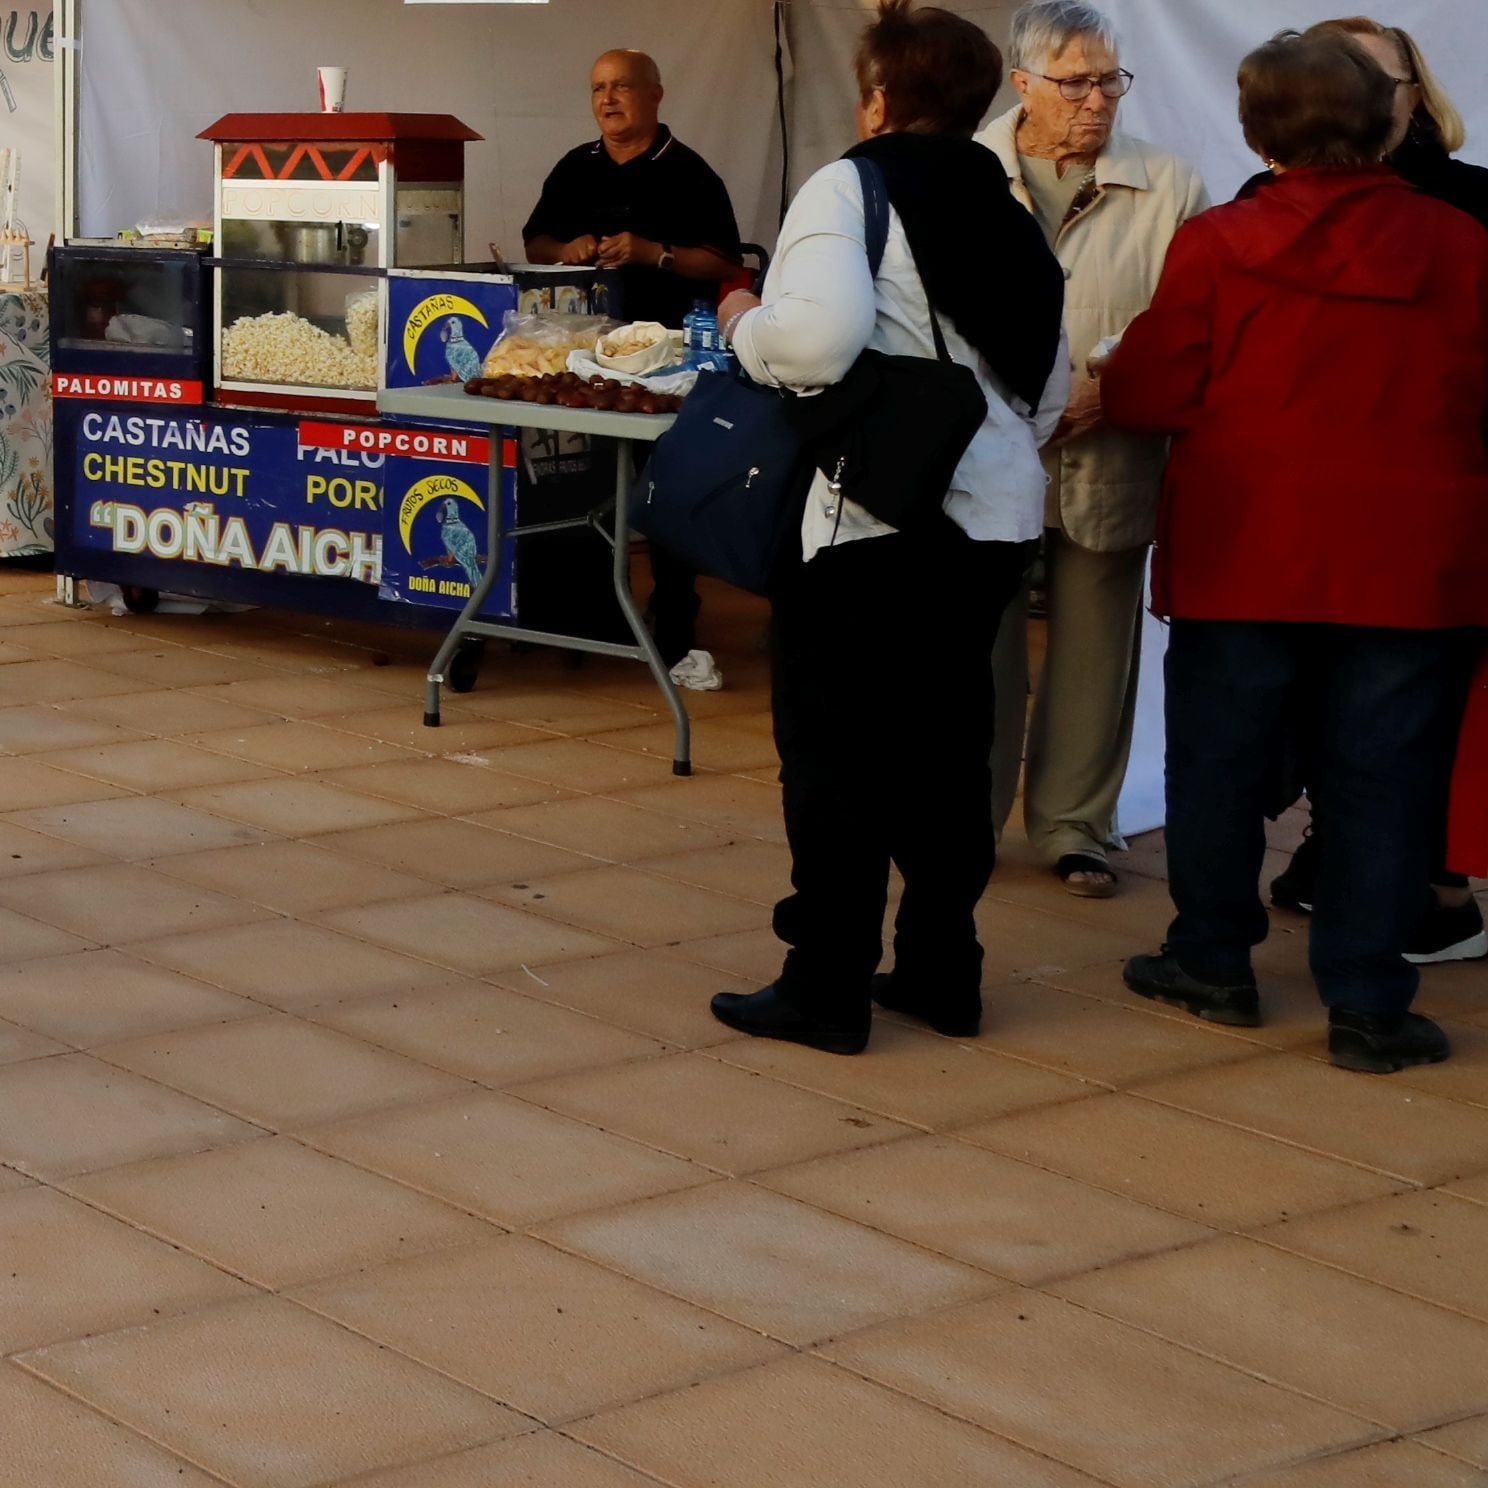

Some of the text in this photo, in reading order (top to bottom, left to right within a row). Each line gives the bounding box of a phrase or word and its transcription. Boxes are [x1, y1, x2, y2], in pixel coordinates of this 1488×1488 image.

[224, 189, 378, 219] POPCORN
[407, 295, 454, 340] CASTAÑAS
[57, 377, 183, 399] PALOMITAS
[82, 412, 251, 457] CASTAÑAS
[343, 429, 468, 457] POPCORN
[83, 452, 251, 497] CHESTNUT
[306, 474, 384, 511] POR
[401, 478, 459, 526] FRUTOS SECOS
[408, 575, 471, 598] DOÑA AICHA
